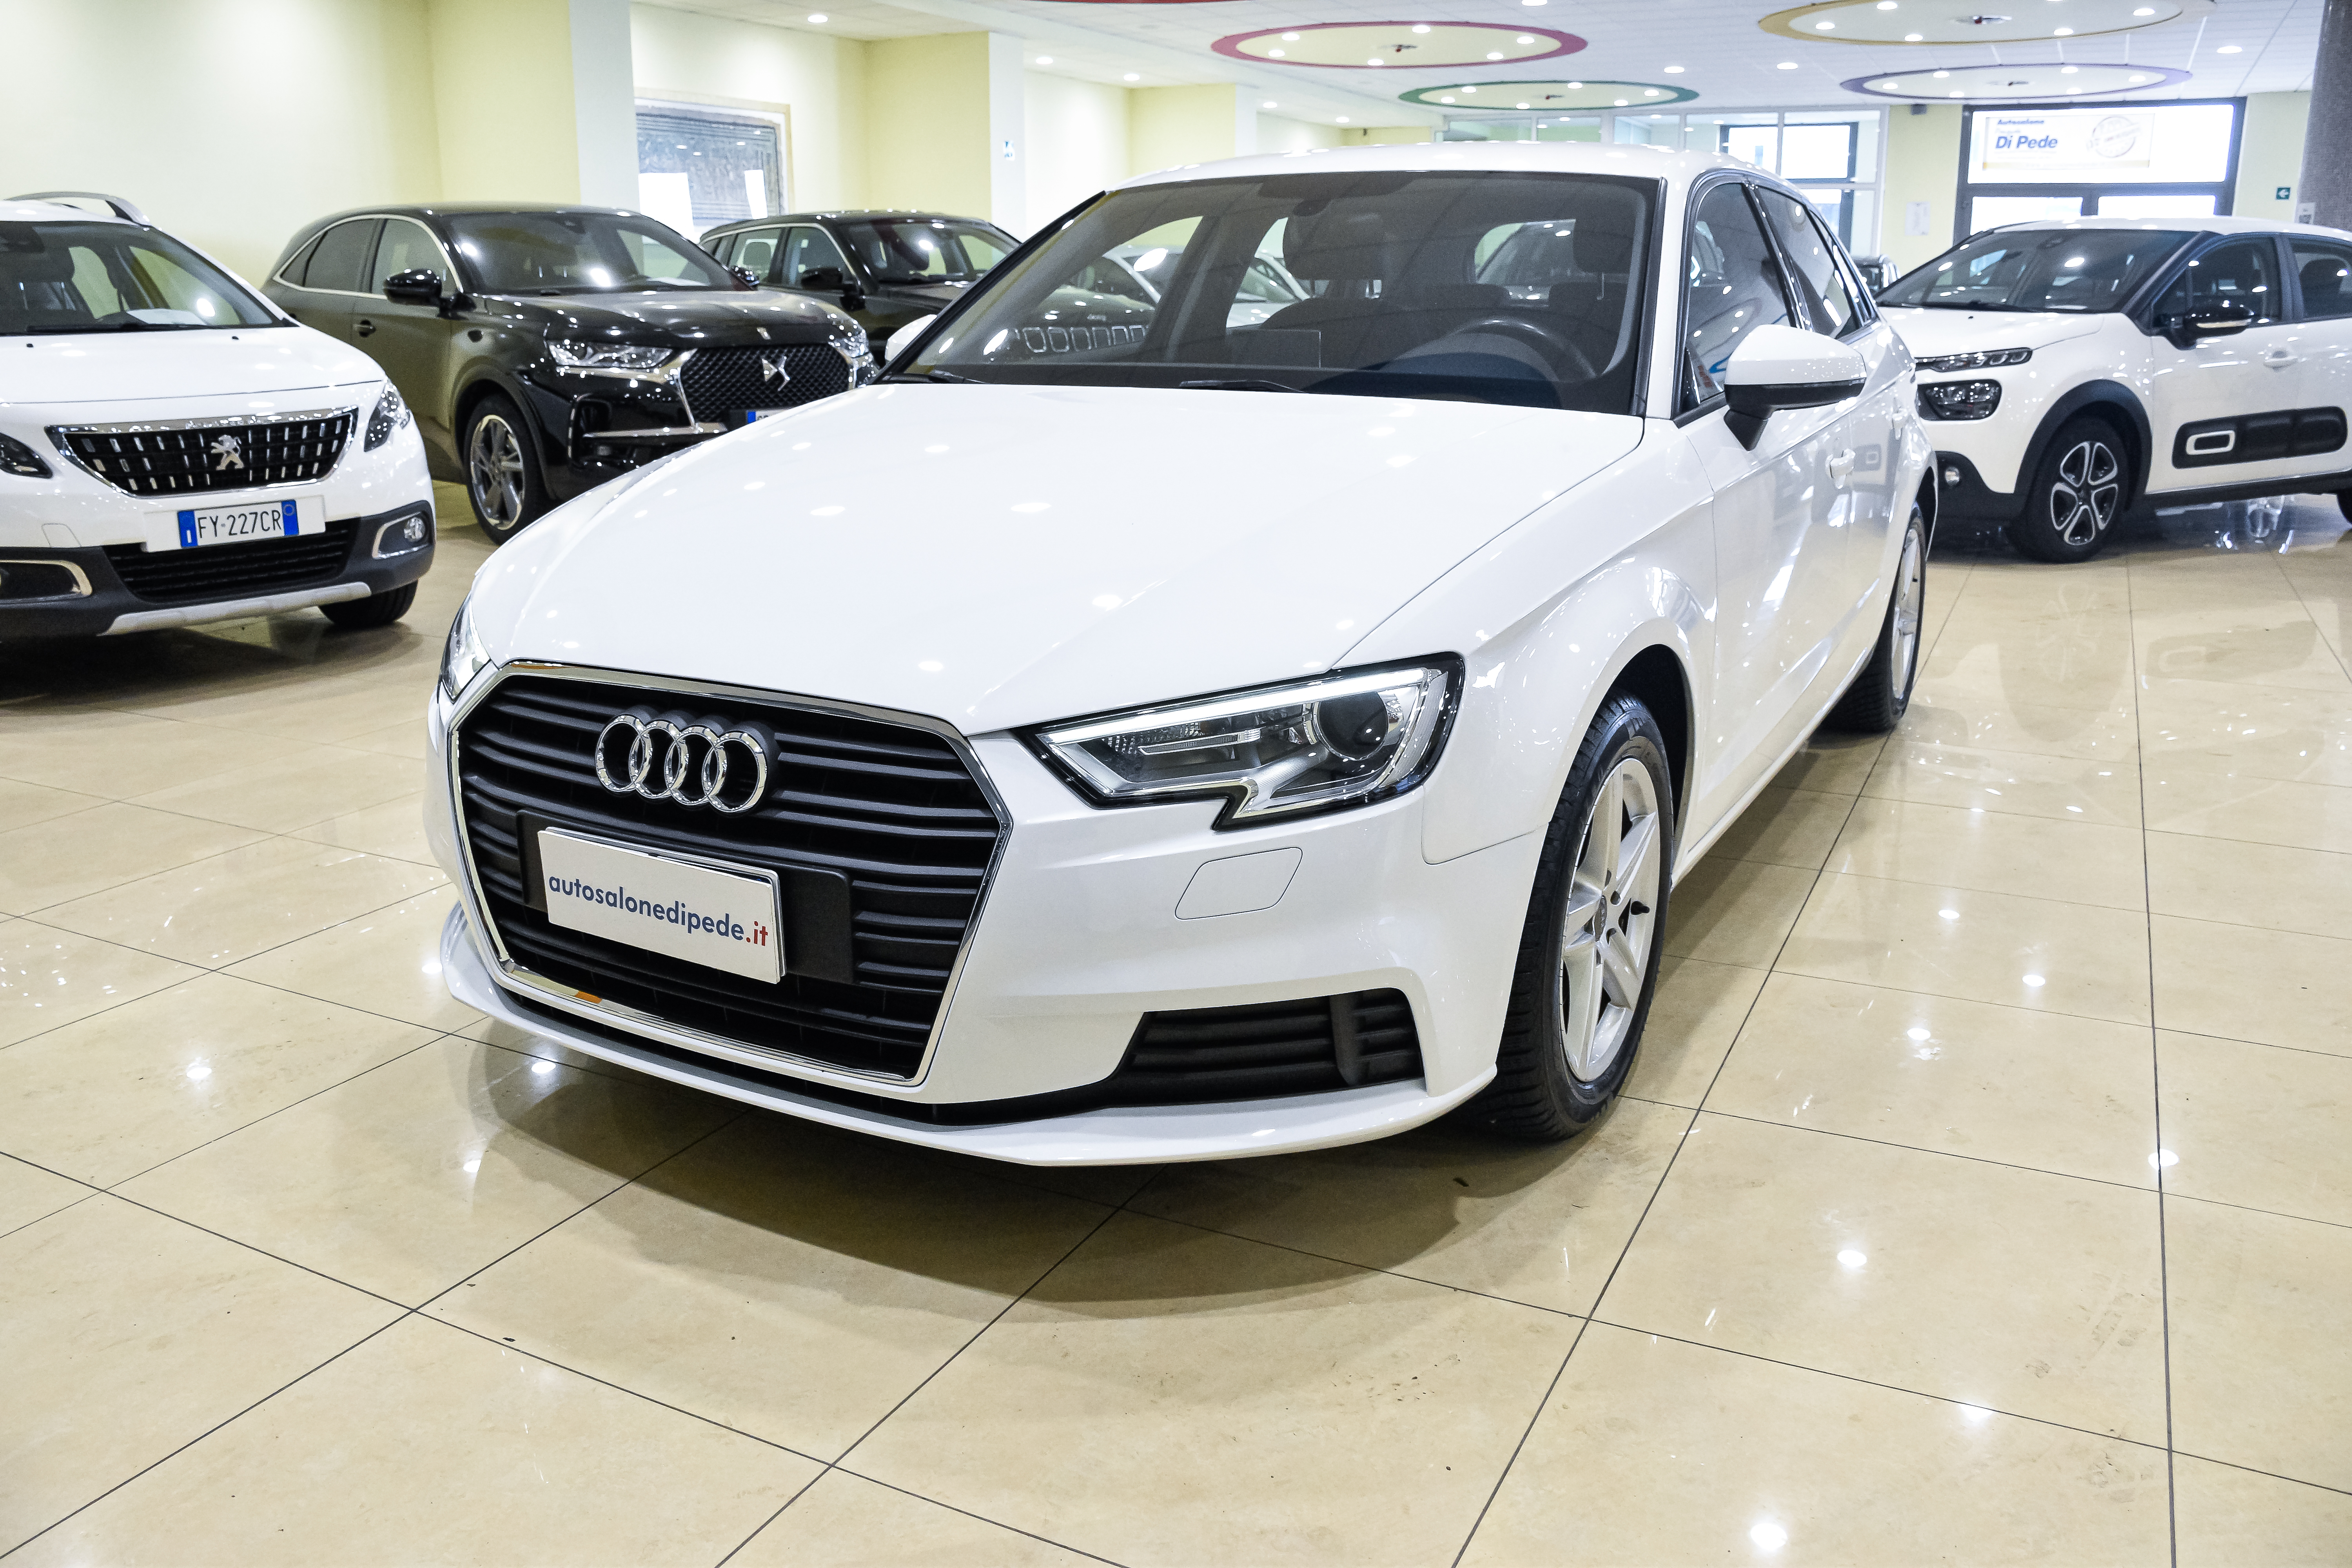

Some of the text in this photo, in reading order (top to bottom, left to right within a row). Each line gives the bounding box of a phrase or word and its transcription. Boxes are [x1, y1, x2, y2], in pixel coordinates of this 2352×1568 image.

[1995, 134, 2058, 149] Di Pede
[549, 875, 768, 946] autosalonedipede.it
